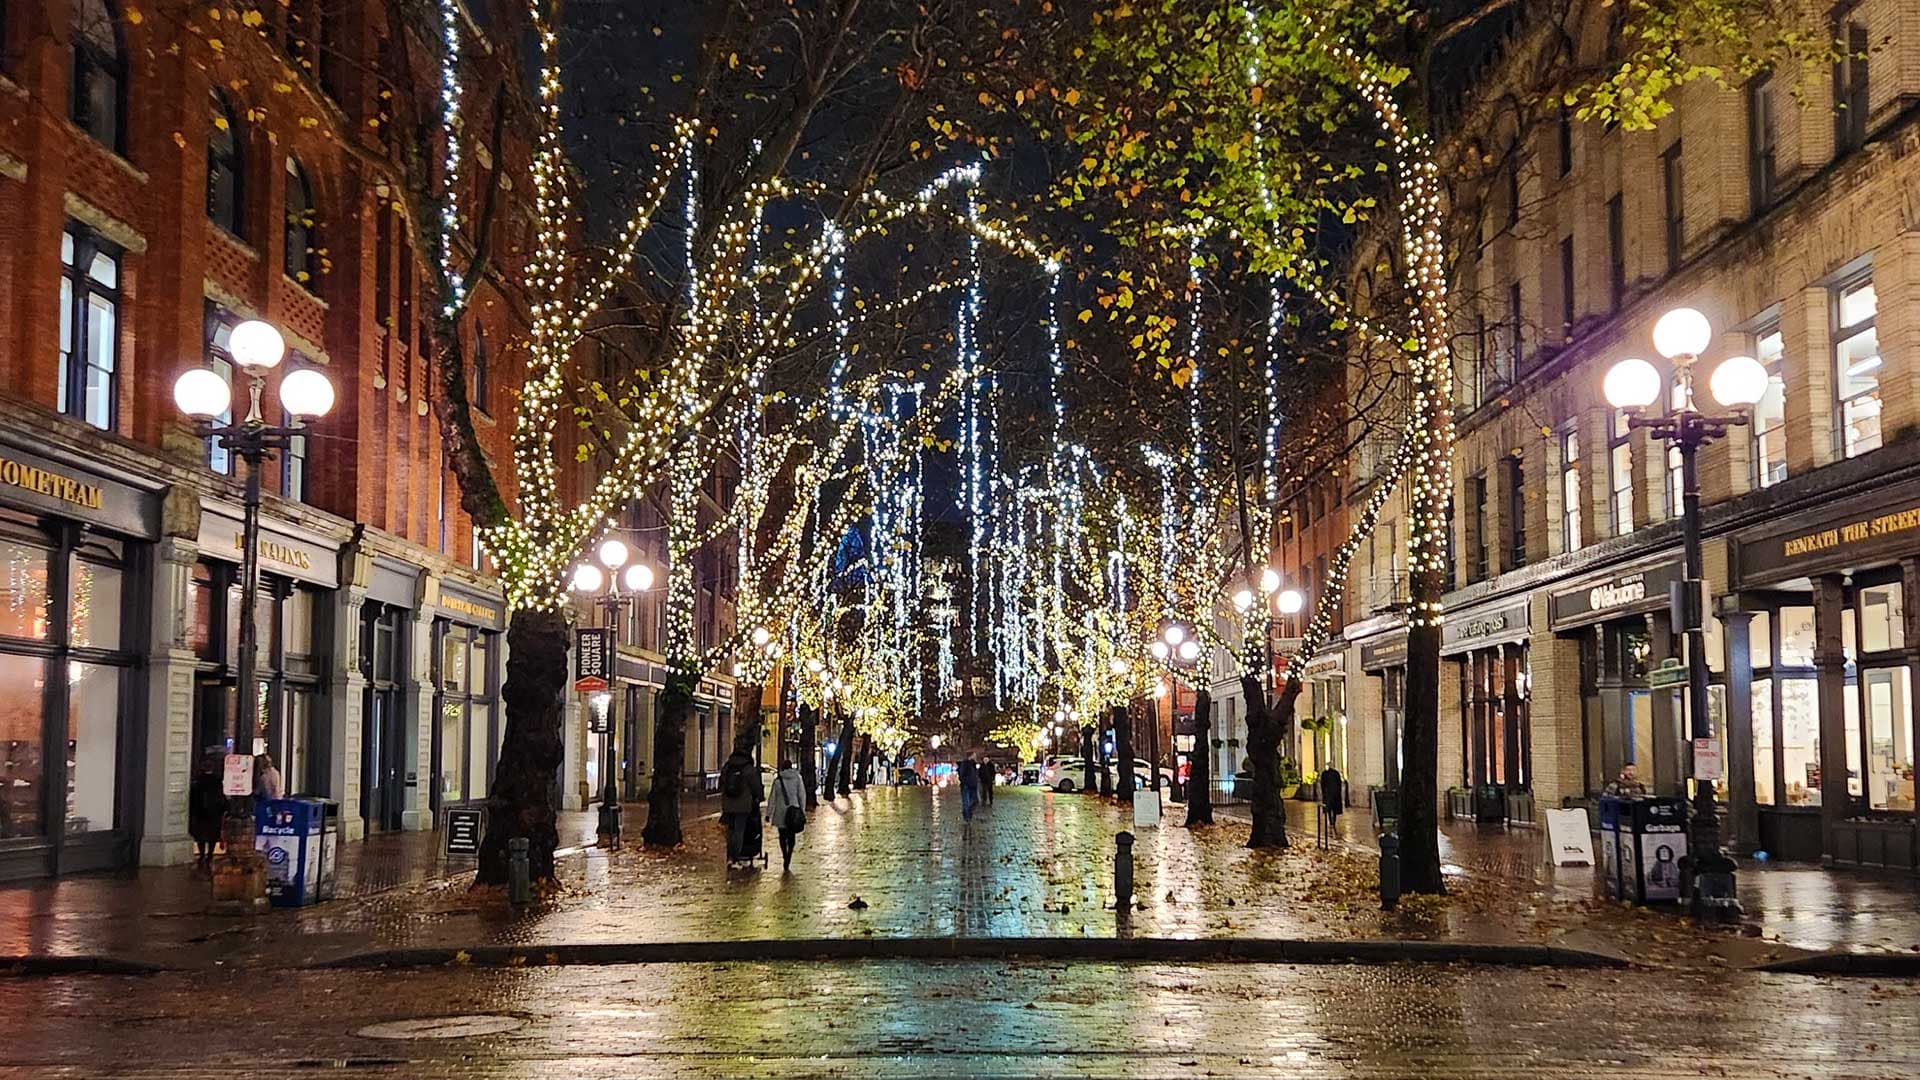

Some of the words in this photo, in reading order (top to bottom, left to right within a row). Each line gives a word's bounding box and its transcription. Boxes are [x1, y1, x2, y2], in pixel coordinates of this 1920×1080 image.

[0, 458, 103, 509] OMETEAM
[1785, 529, 1838, 556] BENEATH
[1841, 521, 1869, 543] THE
[581, 633, 591, 676] PIONEER
[591, 633, 601, 676] SQUARE
[262, 825, 295, 835] Recycle
[1645, 823, 1681, 833] Garbage
